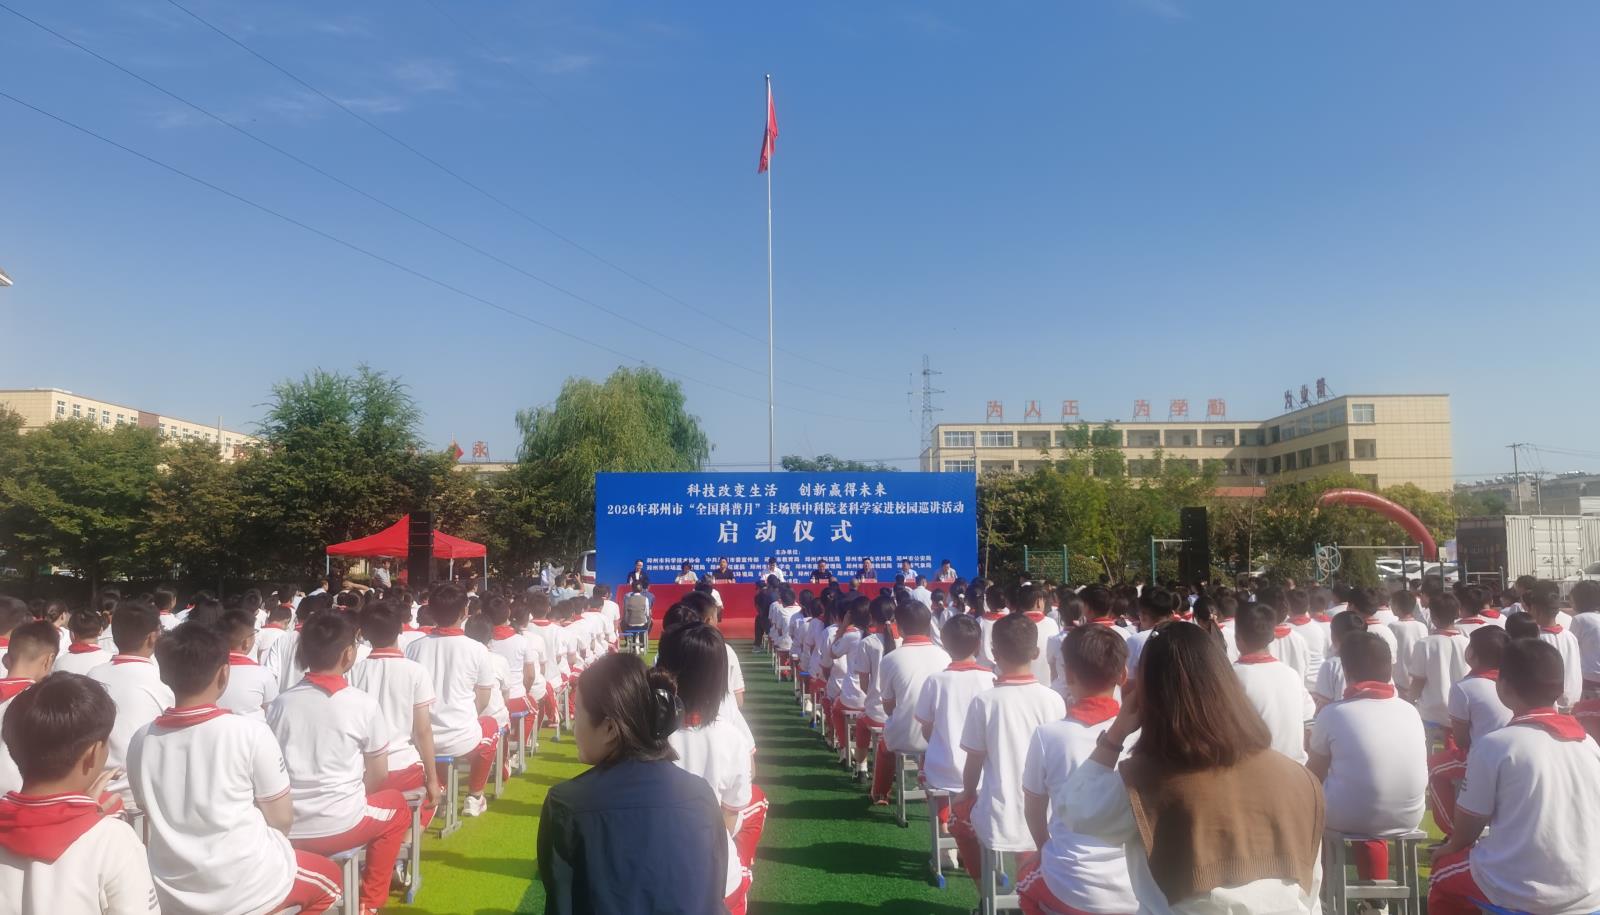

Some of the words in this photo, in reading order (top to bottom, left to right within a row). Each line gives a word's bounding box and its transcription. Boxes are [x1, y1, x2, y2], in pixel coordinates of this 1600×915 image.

[987, 400, 1079, 417] 为人正
[1134, 399, 1225, 416] 为学勤
[687, 483, 778, 498] 科技改变生活
[799, 482, 887, 498] 创新赢得未来
[717, 519, 853, 544] 启动仪式
